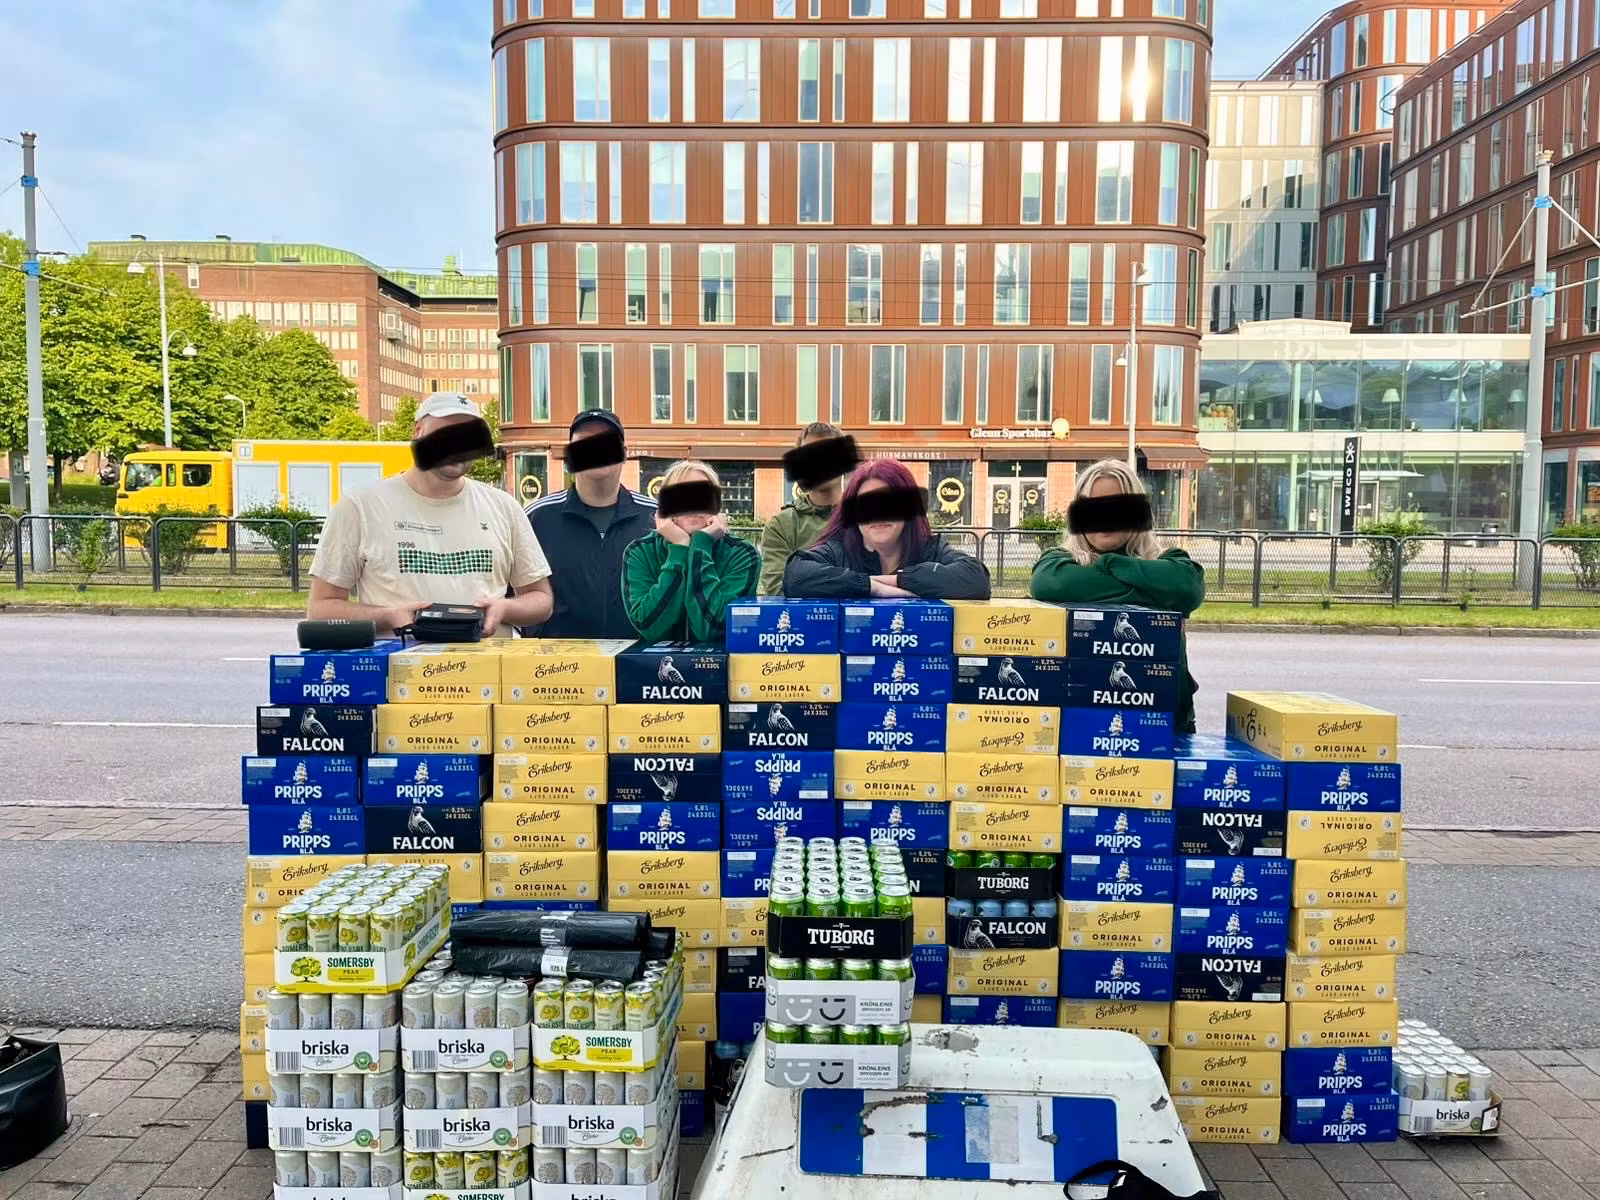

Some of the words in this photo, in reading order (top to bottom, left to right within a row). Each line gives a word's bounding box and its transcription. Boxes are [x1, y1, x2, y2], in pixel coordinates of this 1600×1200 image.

[1001, 428, 1052, 440] Sportsbar
[987, 612, 1031, 629] Eriksberg
[759, 633, 804, 646] PRIPPS
[872, 635, 918, 647] PRIPPS
[984, 638, 1035, 646] ORIGINAL
[1093, 642, 1154, 657] FALCON
[422, 660, 467, 679] Eriksberg
[535, 662, 580, 679] Eriksberg
[762, 659, 805, 677] Eriksberg
[303, 684, 350, 697] PRIPPS
[642, 686, 702, 699] FALCON
[874, 683, 919, 696] PRIPPS
[978, 687, 1039, 701] FALCON
[1093, 691, 1154, 705] FALCON
[409, 711, 454, 728] Eriksberg
[527, 711, 571, 728] Eriksberg
[640, 711, 685, 728] Eriksberg
[1318, 720, 1363, 736] Eriksberg
[283, 738, 344, 751] FALCON
[749, 733, 808, 746] FALCON
[868, 732, 913, 745] PRIPPS
[1093, 737, 1139, 752] PRIPPS
[528, 760, 572, 778] Eriksberg
[634, 758, 694, 771] FALCON
[755, 760, 800, 773] PRIPPS
[866, 758, 910, 774] Eriksberg
[979, 761, 1024, 777] Eriksberg
[1096, 765, 1140, 781] Eriksberg
[275, 786, 322, 798] PRIPPS
[397, 785, 443, 798] PRIPPS
[1090, 789, 1142, 797] ORIGINAL
[1204, 789, 1250, 802] PRIPPS
[1321, 792, 1368, 805] PRIPPS
[516, 809, 560, 827] Eriksberg
[757, 808, 802, 820] PRIPPS
[986, 809, 1030, 826] Eriksberg
[1203, 813, 1262, 827] FALCON
[283, 835, 330, 848] PRIPPS
[640, 831, 685, 844] PRIPPS
[871, 828, 916, 841] PRIPPS
[1096, 835, 1141, 848] PRIPPS
[393, 836, 454, 849] FALCON
[283, 863, 329, 882] Eriksberg
[519, 858, 564, 876] Eriksberg
[641, 857, 685, 874] Eriksberg
[1330, 865, 1373, 883] Eriksberg
[977, 877, 1029, 889] TUBORG
[1097, 883, 1143, 895] PRIPPS
[1212, 887, 1258, 900] PRIPPS
[647, 906, 686, 921] riksberg
[1098, 910, 1141, 926] Eriksberg
[989, 922, 1046, 934] FALCON
[1333, 913, 1375, 931] Eriksberg
[808, 928, 874, 945] TUBORG
[1207, 936, 1253, 949] PRIPPS
[328, 958, 375, 968] SOMERSBY
[983, 954, 1025, 971] Eriksberg
[1202, 959, 1261, 973] FALCON
[1320, 959, 1364, 977] Eriksberg
[1095, 981, 1140, 994] PRIPPS
[1096, 1004, 1138, 1020] Eriksberg
[1209, 1009, 1252, 1025] Eriksberg
[1324, 1007, 1366, 1024] Eriksberg
[586, 1036, 632, 1048] SOMERSBY
[1206, 1033, 1256, 1041] ORIGINAL
[302, 1040, 349, 1055] briska
[439, 1039, 484, 1054] briska
[1204, 1055, 1248, 1071] Eriksberg
[1201, 1080, 1251, 1088] ORIGINAL
[1319, 1076, 1362, 1088] PRIPPS
[1205, 1102, 1249, 1119] Eriksberg
[1436, 1108, 1470, 1120] briska
[306, 1116, 352, 1131] briska
[443, 1117, 490, 1132] briska
[569, 1115, 614, 1130] briska
[1200, 1126, 1251, 1134] ORIGINAL
[1322, 1124, 1366, 1136] PRIPPS
